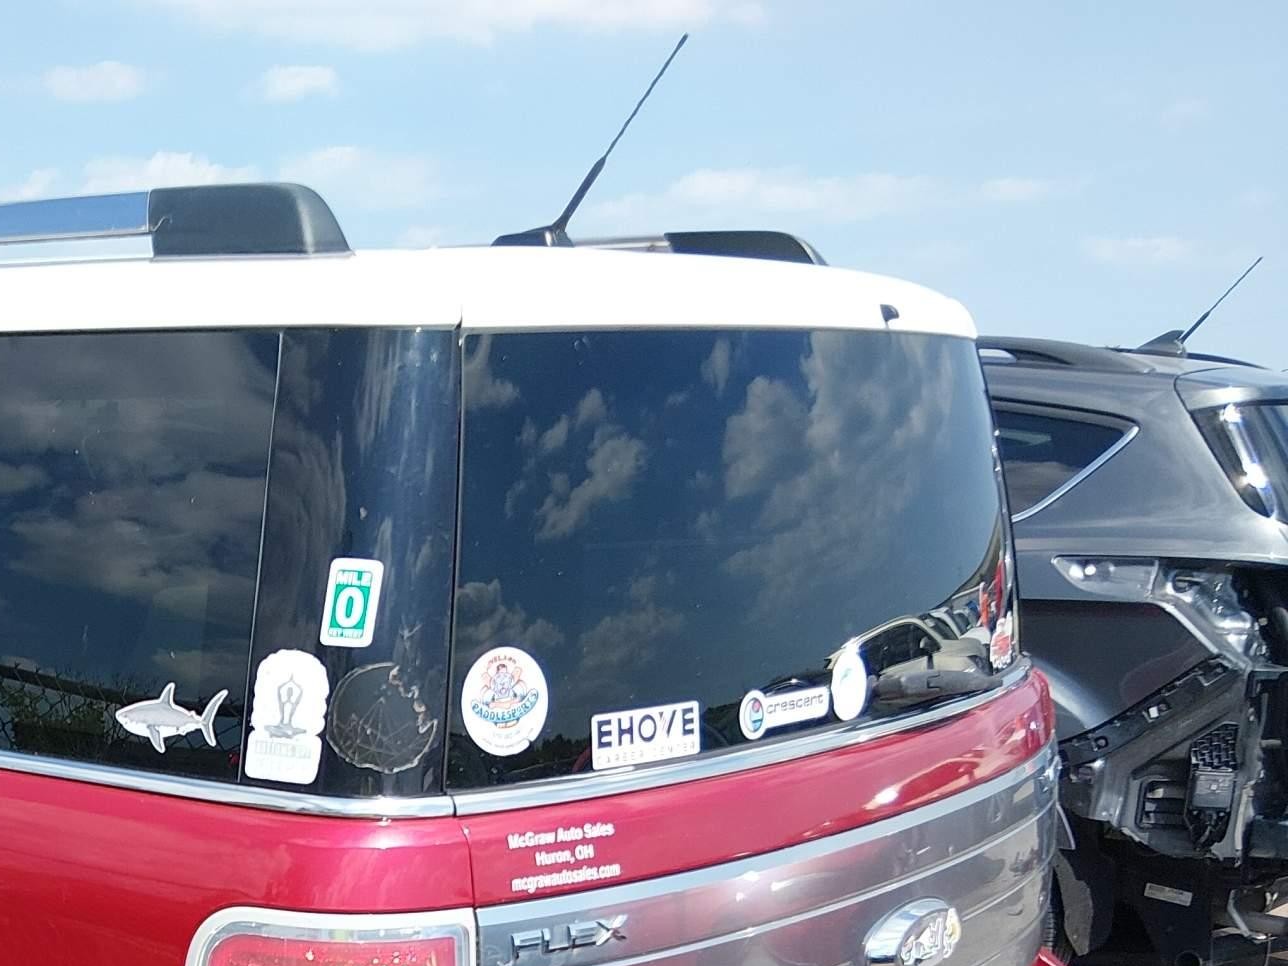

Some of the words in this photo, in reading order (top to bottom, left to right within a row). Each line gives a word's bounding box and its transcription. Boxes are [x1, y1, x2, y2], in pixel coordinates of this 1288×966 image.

[336, 571, 372, 586] MILE
[335, 587, 365, 628] 0
[766, 693, 824, 715] crescent
[597, 707, 695, 750] EHOVE
[507, 831, 556, 849] McGraw
[556, 826, 584, 842] Auto
[583, 822, 615, 839] Sales
[535, 849, 576, 867] Huron,
[574, 843, 595, 860] OH
[511, 863, 621, 894] mcgrawautosales.com
[511, 914, 629, 960] FLEX
